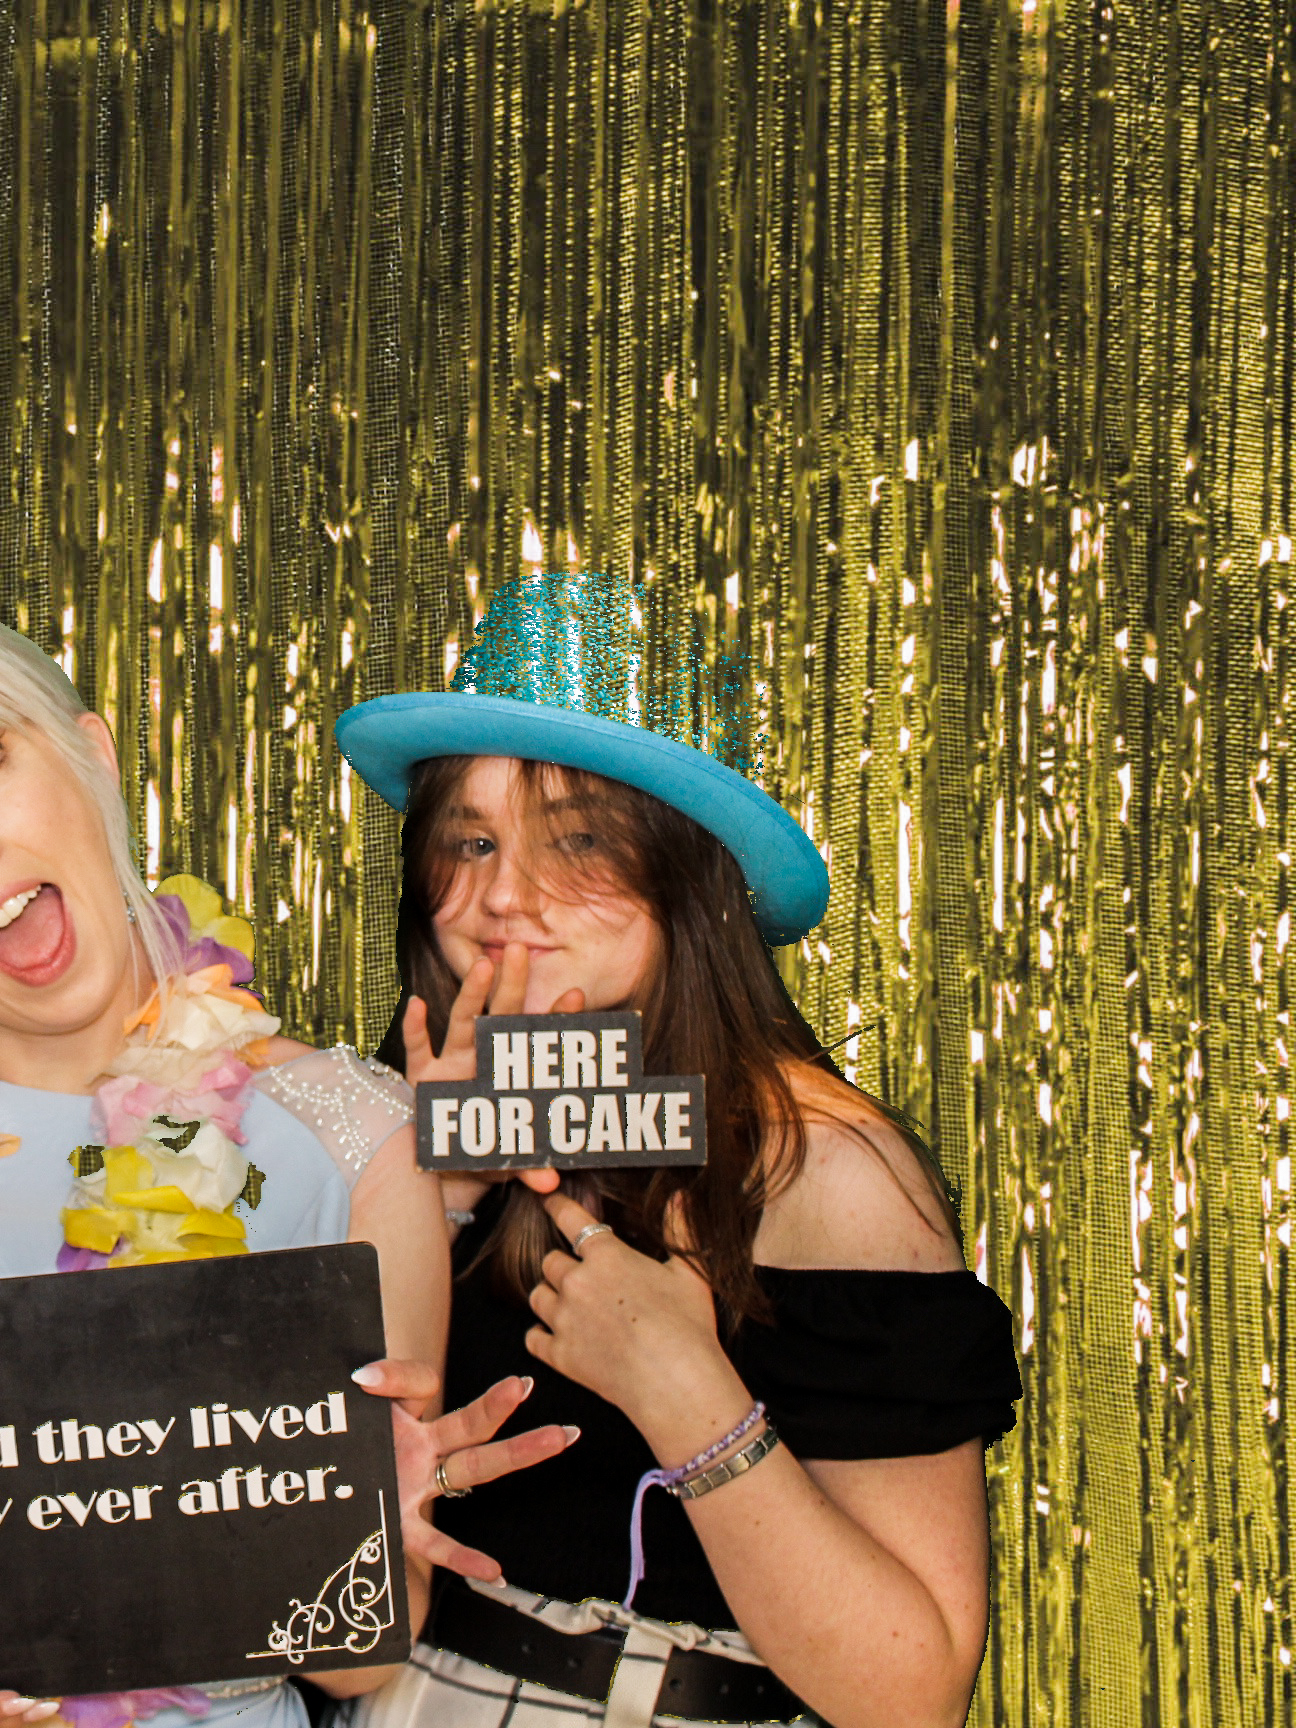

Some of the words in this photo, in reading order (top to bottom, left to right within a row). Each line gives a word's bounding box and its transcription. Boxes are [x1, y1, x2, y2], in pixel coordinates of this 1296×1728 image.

[492, 1028, 629, 1090] HERE
[432, 1096, 535, 1157] FOR
[548, 1092, 692, 1154] CAKE
[32, 1415, 176, 1463] they
[189, 1391, 348, 1449] lived
[26, 1483, 163, 1531] ever
[177, 1464, 354, 1516] after.
